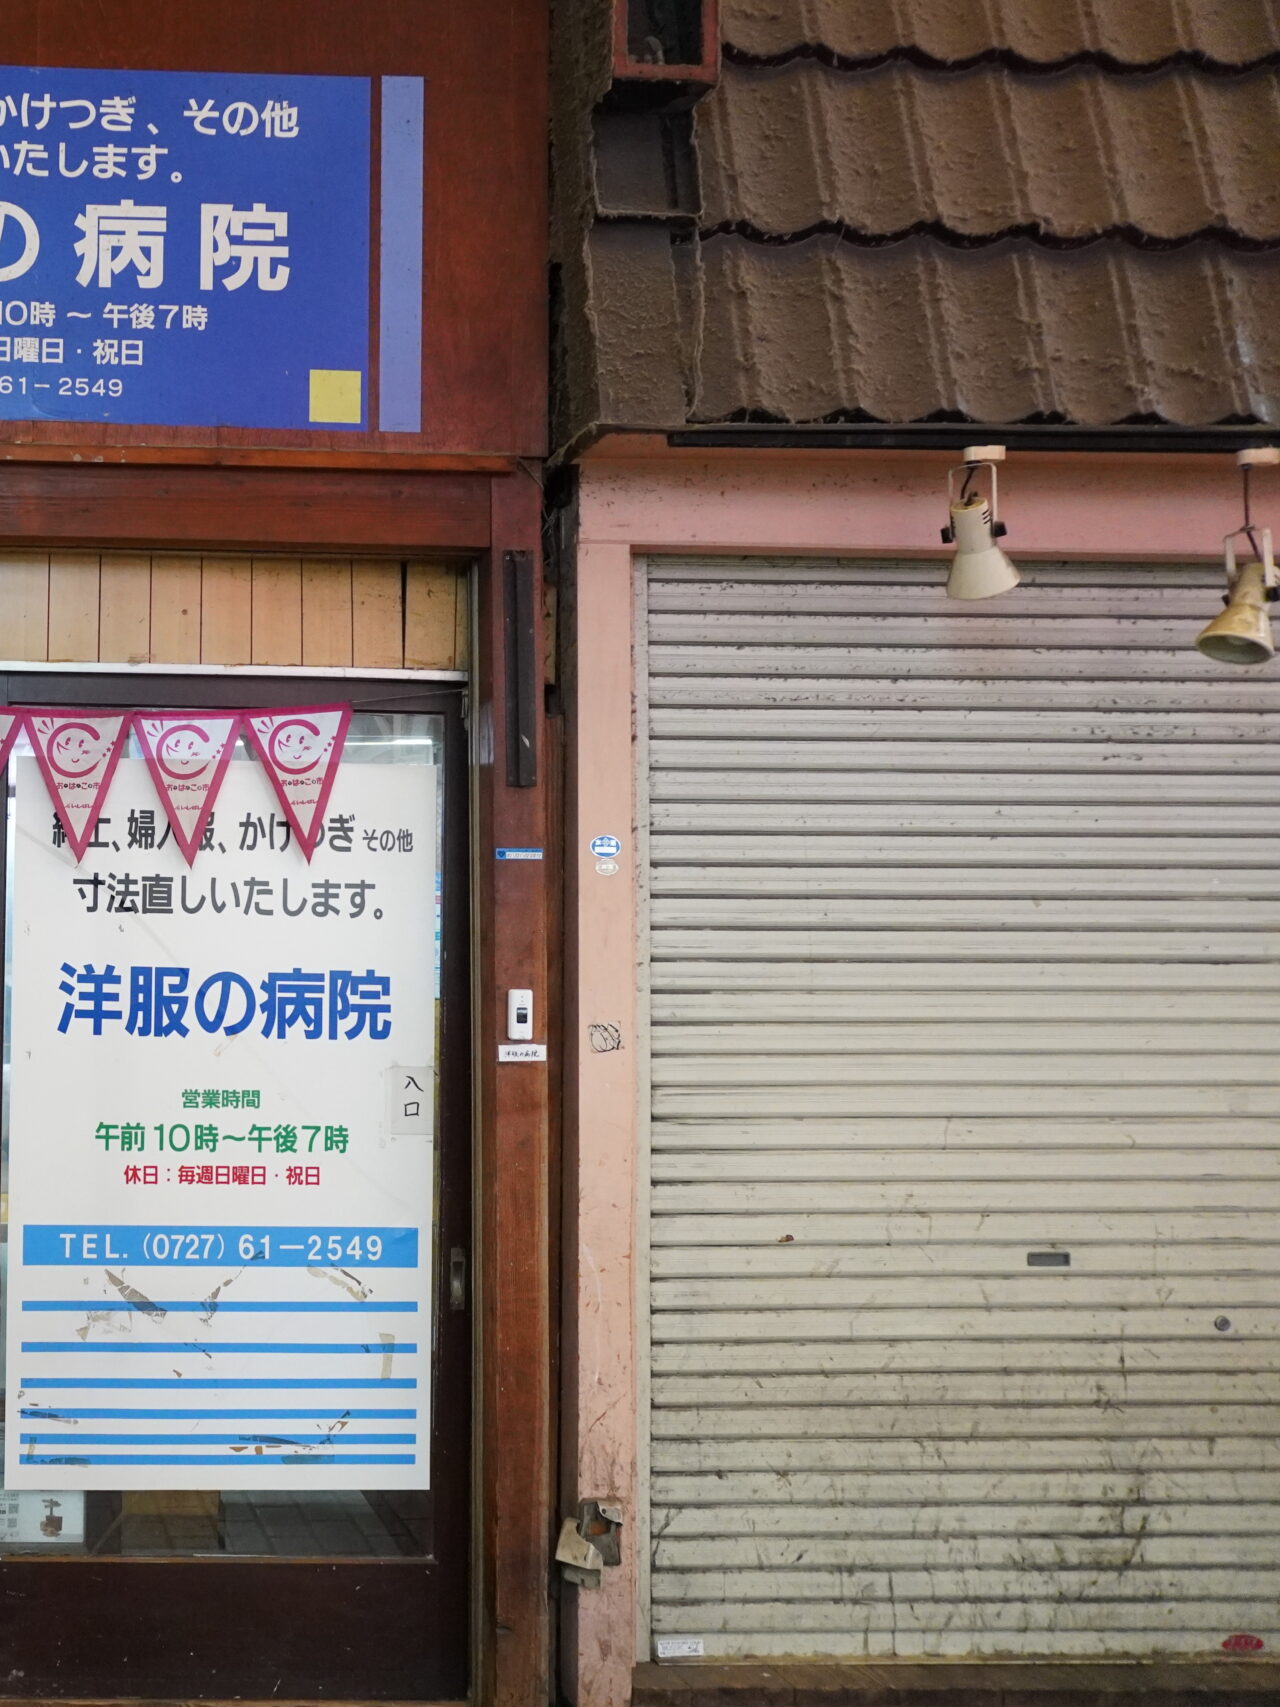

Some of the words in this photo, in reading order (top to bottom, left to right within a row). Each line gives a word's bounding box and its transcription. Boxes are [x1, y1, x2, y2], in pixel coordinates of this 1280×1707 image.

[363, 829, 414, 853] その他
[73, 873, 383, 921] 寸法直しいたします。
[57, 962, 393, 1041] 洋服の病院
[181, 1089, 261, 1109] 営業時間
[404, 1075, 424, 1117] 入口
[59, 1233, 128, 1259] TEL.
[141, 1232, 226, 1260] (0727)
